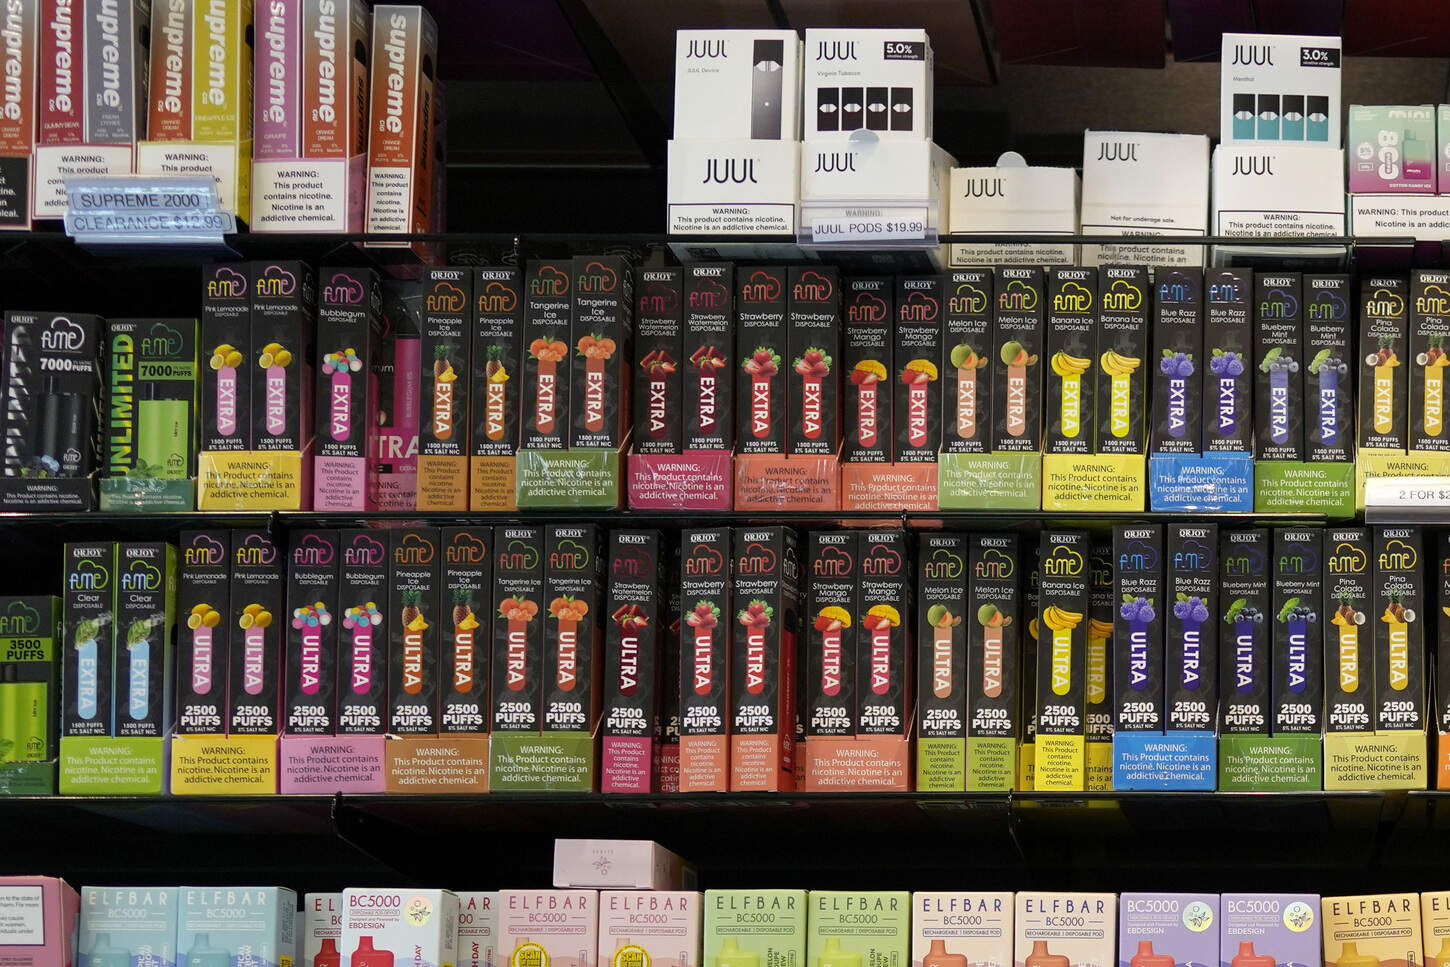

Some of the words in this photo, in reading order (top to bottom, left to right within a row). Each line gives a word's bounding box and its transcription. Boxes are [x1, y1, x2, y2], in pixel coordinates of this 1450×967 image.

[686, 40, 727, 58] JUUL
[816, 41, 857, 61] JUUL
[886, 43, 912, 54] 5.0%
[1232, 45, 1273, 65] JUUL
[1302, 50, 1328, 61] 3.0%
[270, 0, 288, 123] supreme
[384, 15, 407, 134] supreme
[1098, 142, 1138, 162] JUUL
[703, 159, 757, 183] JUUL
[1232, 156, 1273, 176] JUUL
[80, 194, 162, 207] SUPREME
[164, 194, 200, 207] 2000
[74, 216, 169, 231] CLEARANCE
[174, 216, 223, 230] $12.99
[694, 216, 721, 224] product
[815, 224, 845, 234] JUUL
[849, 223, 882, 233] PODS
[886, 222, 922, 232] $19.99
[1058, 272, 1086, 280] QRJOY
[320, 309, 365, 319] Bubblegum
[740, 312, 783, 324] Strawberry
[1161, 309, 1176, 317] Blue
[1051, 316, 1080, 324] Banana
[1082, 316, 1093, 324] Ice
[40, 359, 72, 371] 7000
[73, 364, 92, 372] PUFFS
[111, 334, 135, 480] UNLIMITED
[218, 379, 234, 429] EXTRA
[752, 382, 769, 433] EXTRA
[657, 464, 700, 472] WARNING:
[1400, 491, 1407, 500] 2
[1409, 491, 1435, 500] FOR
[735, 580, 777, 590] Strawberry
[77, 594, 99, 602] Clear
[9, 640, 41, 650] 3500
[7, 650, 44, 660] PUFFS
[1130, 632, 1146, 684] ULTRA
[194, 635, 210, 688] ULTRA
[739, 706, 769, 716] 2500
[735, 716, 773, 727] PUFFS
[201, 746, 246, 755] WARNING:
[349, 895, 400, 908] BC5000
[943, 916, 981, 926] BC5000
